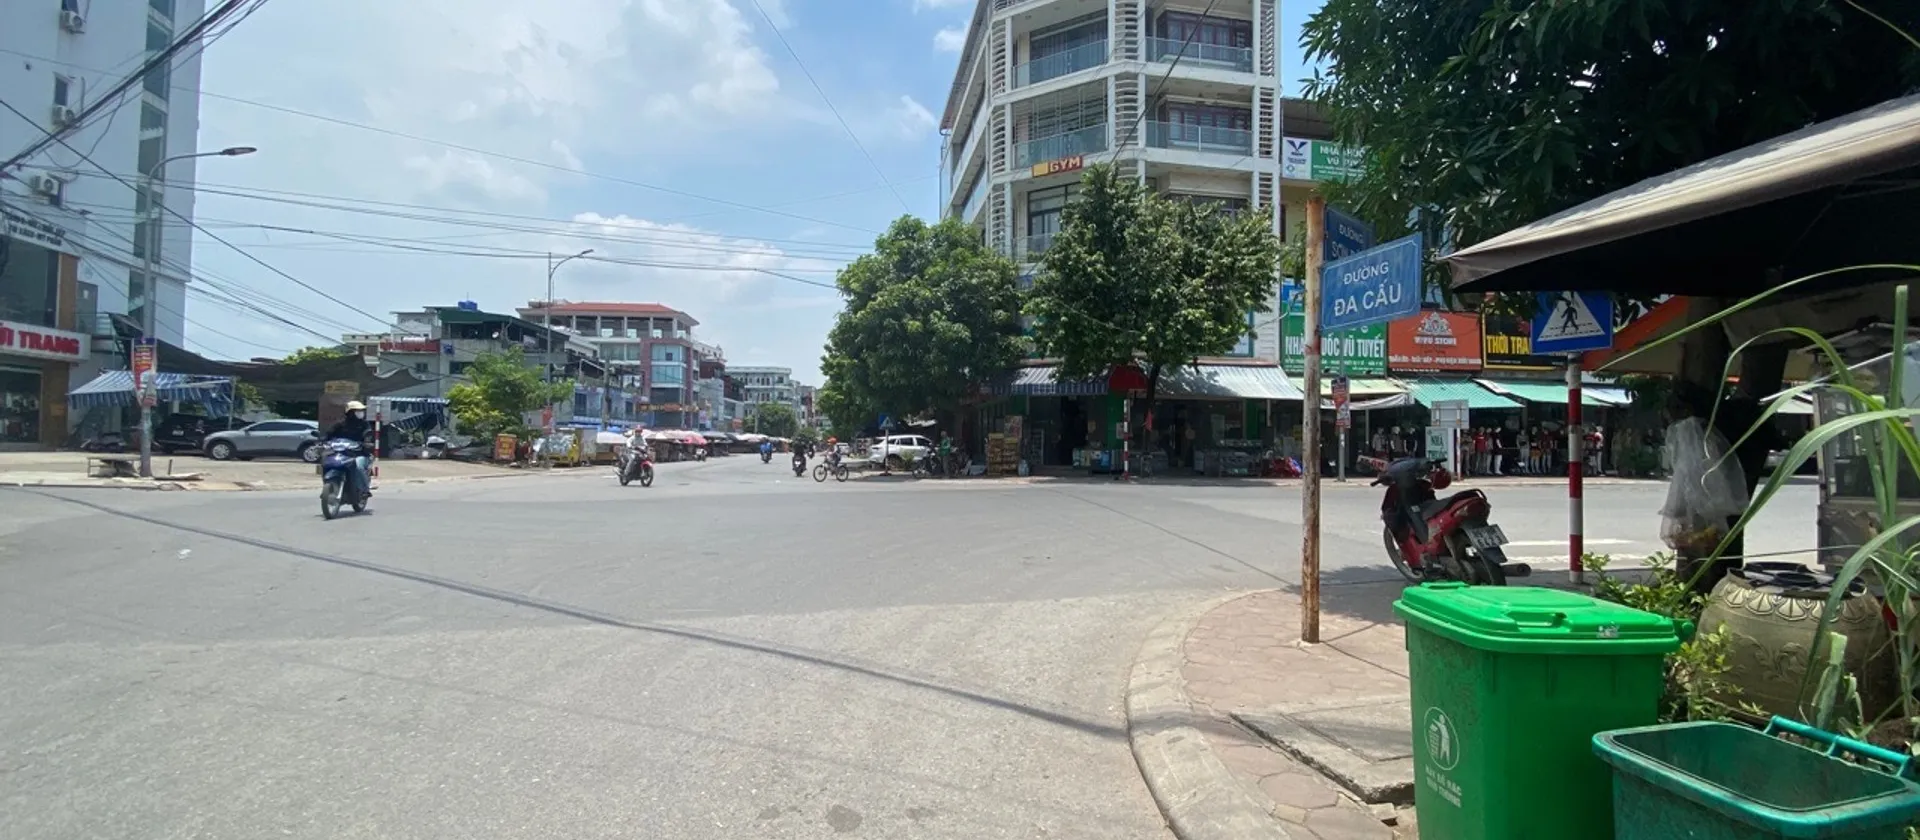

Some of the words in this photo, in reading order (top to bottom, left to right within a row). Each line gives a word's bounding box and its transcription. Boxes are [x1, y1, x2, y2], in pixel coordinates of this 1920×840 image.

[1050, 155, 1080, 172] GYM
[1344, 261, 1389, 285] ĐƯỜNG
[1334, 295, 1358, 317] ĐA
[1362, 278, 1401, 310] CẤU
[18, 330, 80, 355] TRANG
[1356, 332, 1385, 358] TUYẾT
[1486, 331, 1509, 354] THỜI
